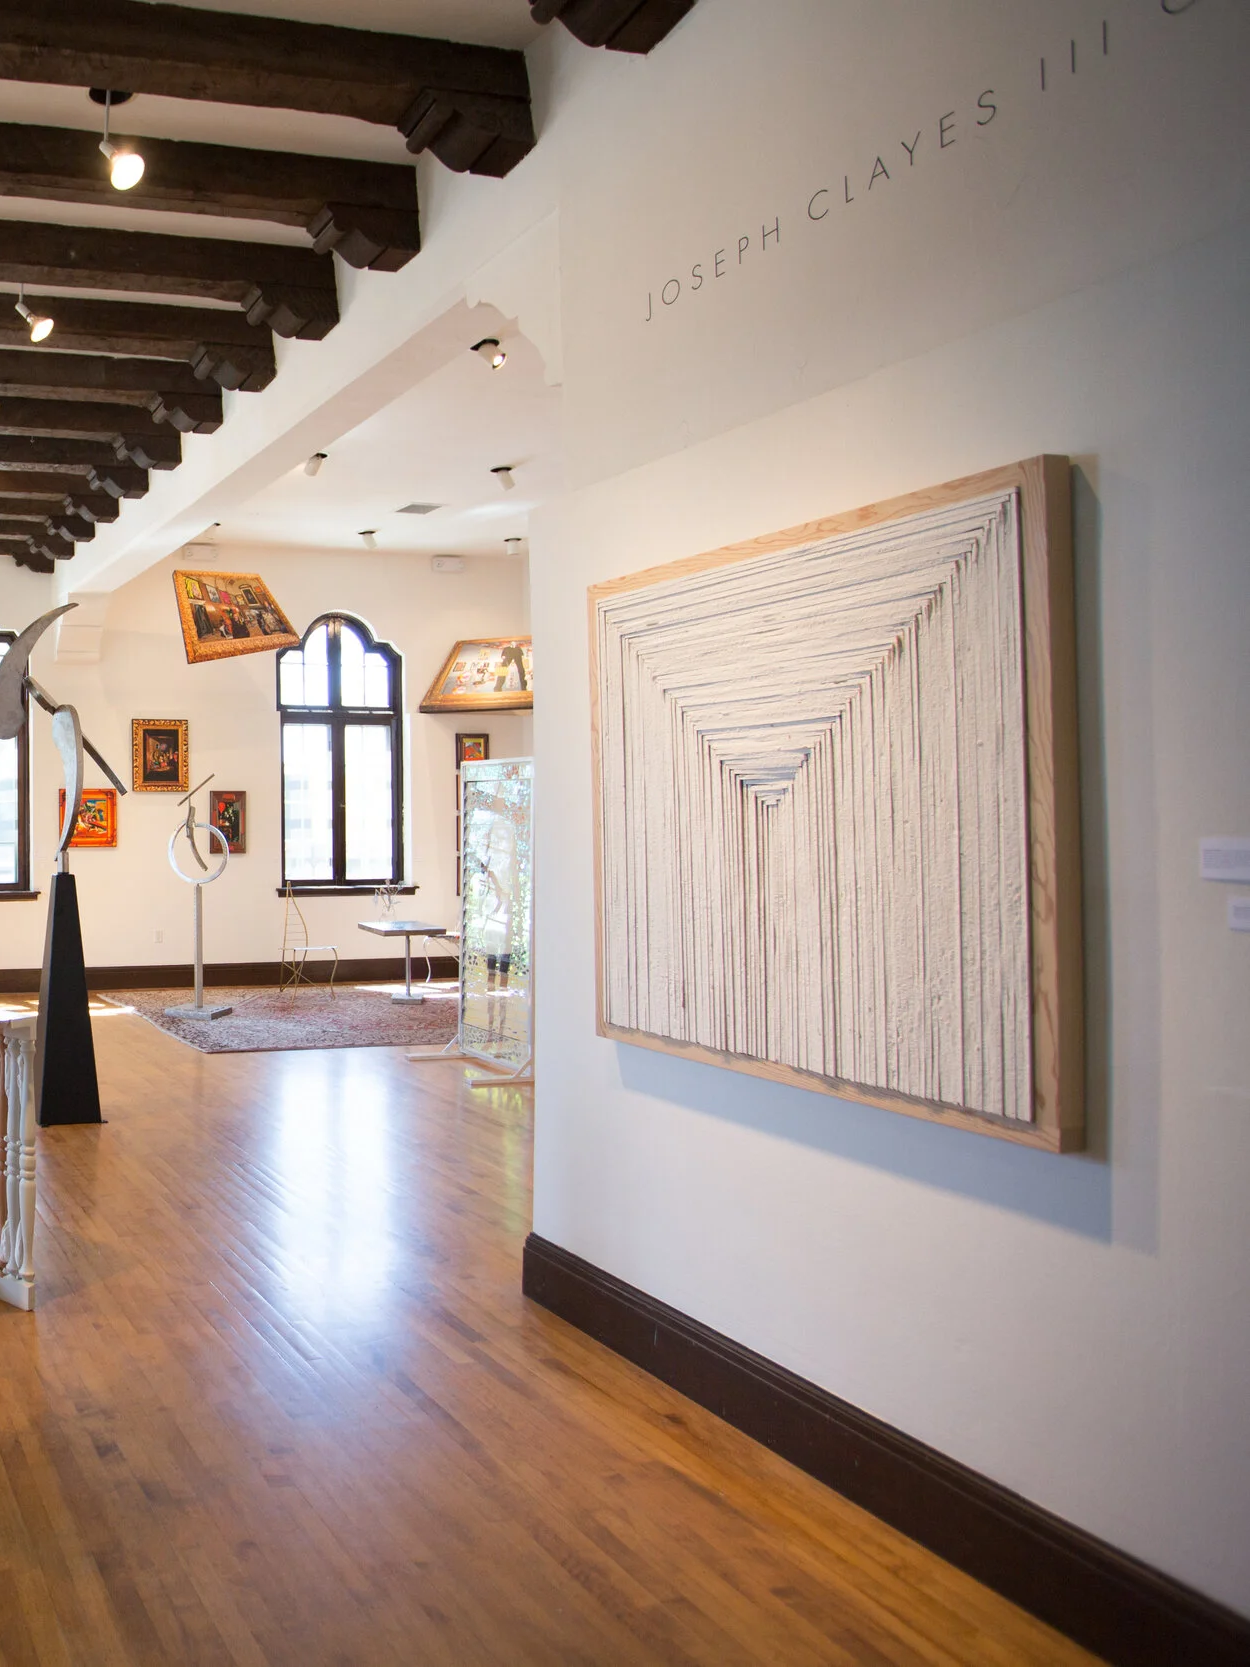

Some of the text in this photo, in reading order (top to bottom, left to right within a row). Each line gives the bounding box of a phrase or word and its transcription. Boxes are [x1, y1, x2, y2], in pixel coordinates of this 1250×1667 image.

[645, 19, 1108, 322] JOSEPH CLAYES III
